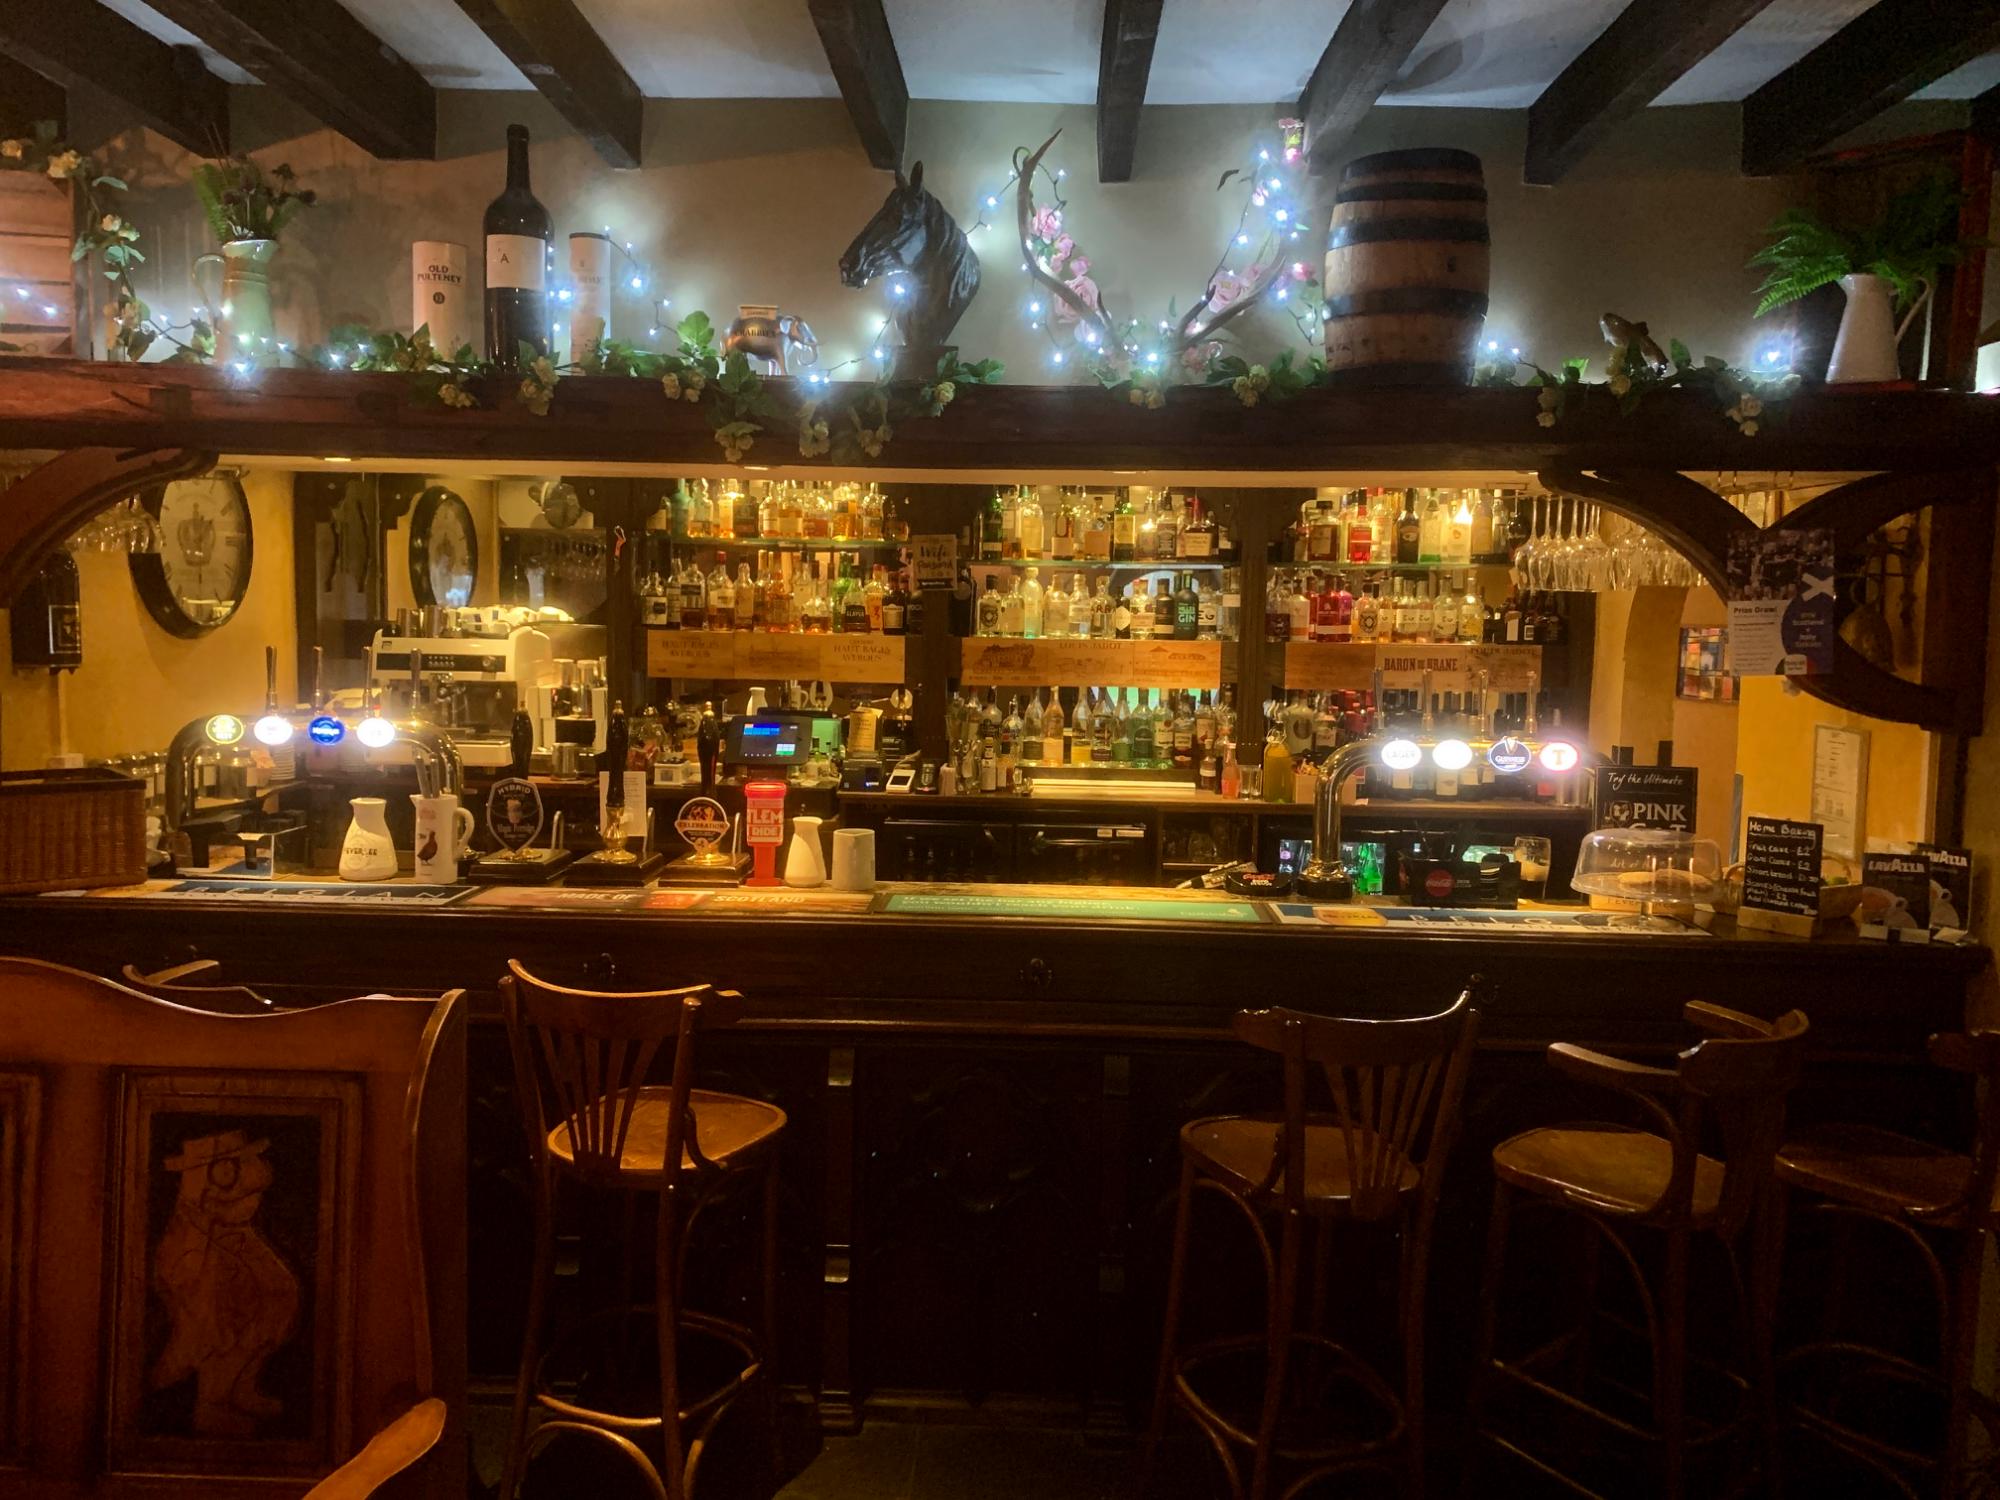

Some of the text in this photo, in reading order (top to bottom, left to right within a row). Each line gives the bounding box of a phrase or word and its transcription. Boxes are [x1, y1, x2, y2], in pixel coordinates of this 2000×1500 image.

[500, 253, 510, 264] A
[428, 264, 449, 274] OLD
[417, 272, 462, 284] PULTENEY
[1178, 614, 1196, 623] GIN
[833, 644, 861, 653] HAUT
[1384, 658, 1416, 671] BARON
[1426, 658, 1458, 671] BRANE
[1551, 750, 1566, 765] T
[1607, 772, 1684, 791] Try the Ultimate
[498, 784, 531, 795] HYBRID
[1633, 802, 1688, 821] PINK
[751, 826, 779, 837] RIDE
[1749, 821, 1776, 833] Home
[1867, 858, 1925, 873] LAVAZZA
[712, 894, 807, 903] SCOTLAND
